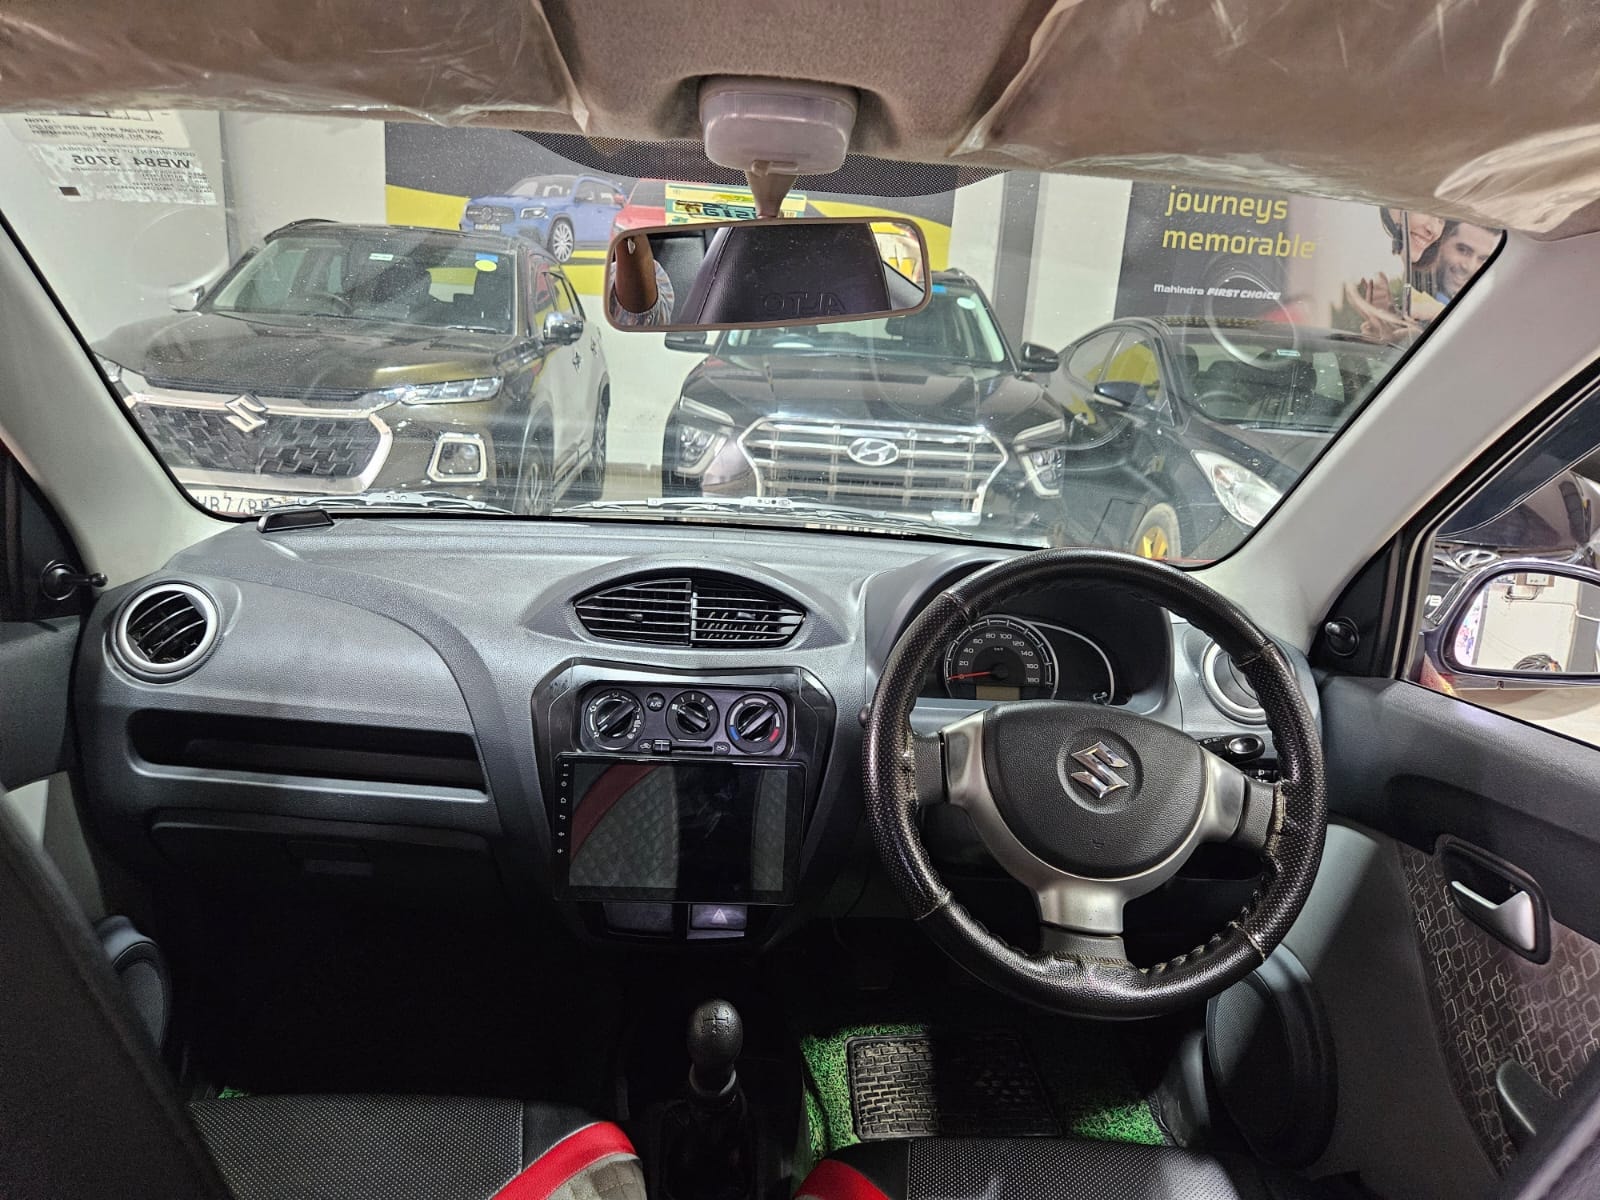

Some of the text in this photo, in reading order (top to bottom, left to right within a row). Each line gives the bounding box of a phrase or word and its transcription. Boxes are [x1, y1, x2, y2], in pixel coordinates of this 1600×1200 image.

[1164, 185, 1289, 225] journeys
[1162, 229, 1316, 259] memorable
[1206, 287, 1240, 298] FIRST
[1240, 290, 1281, 300] CHOICE
